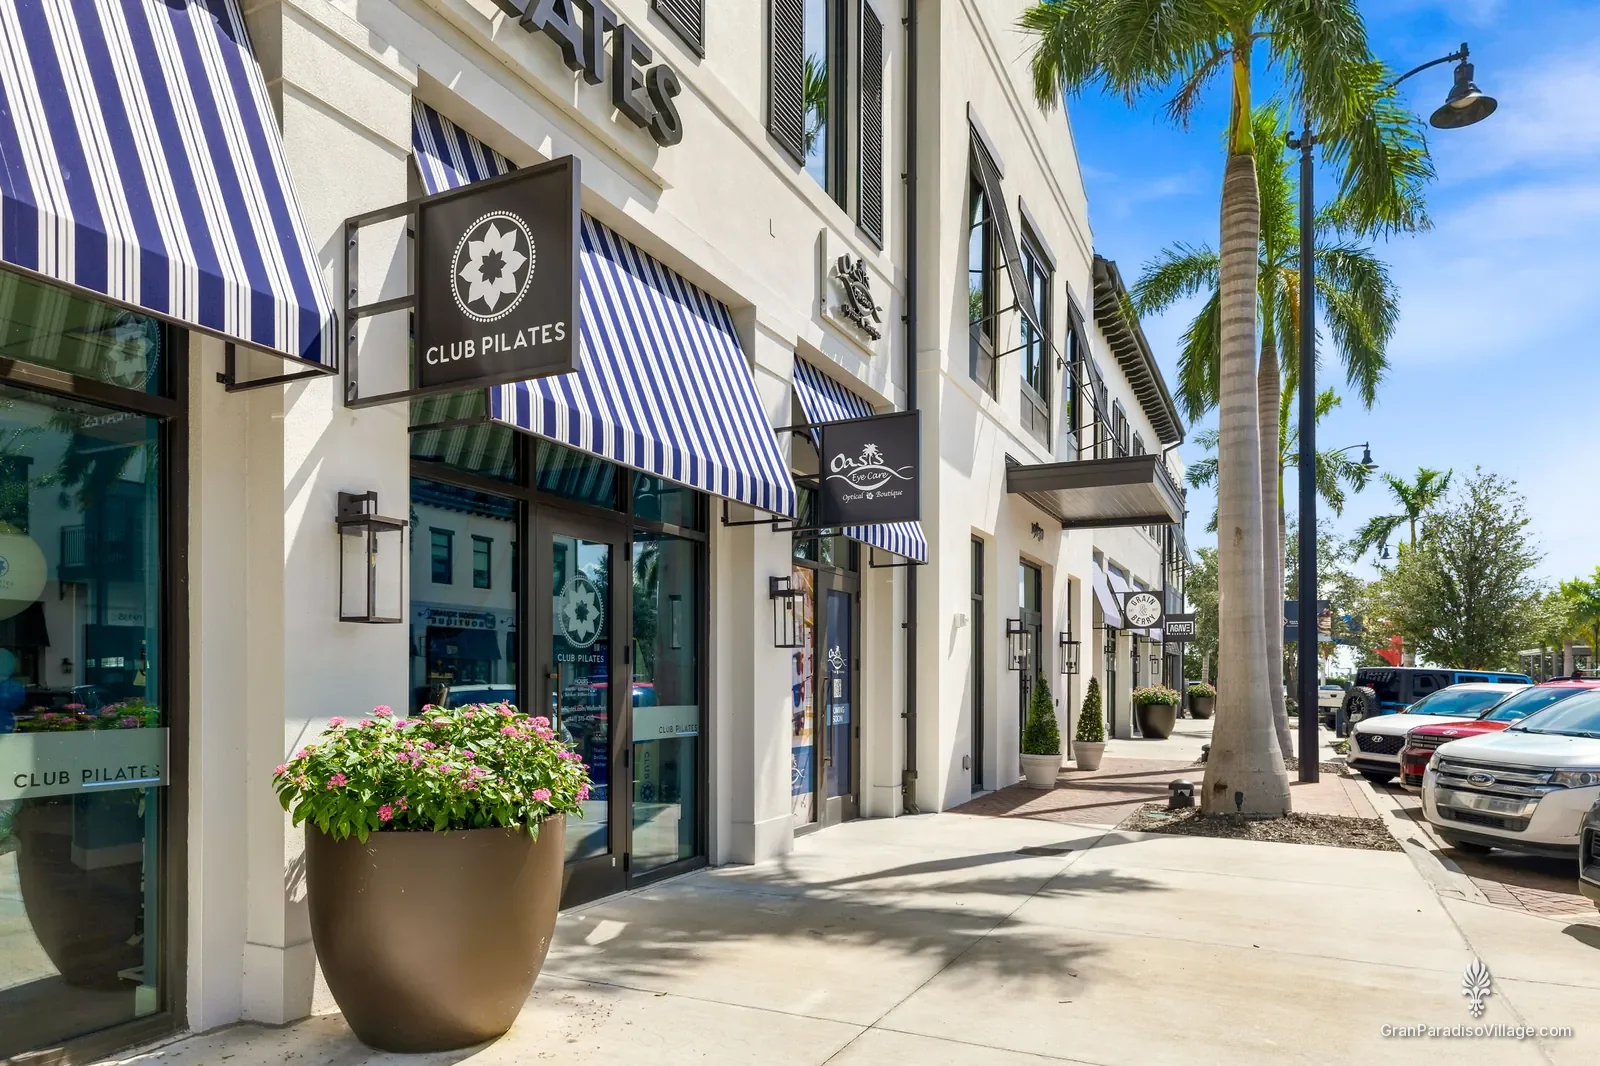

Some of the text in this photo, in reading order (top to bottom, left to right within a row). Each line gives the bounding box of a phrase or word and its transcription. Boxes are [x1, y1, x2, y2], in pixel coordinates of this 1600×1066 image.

[489, 0, 683, 147] ATES
[426, 321, 566, 365] CLUB PILATES
[830, 451, 885, 473] Oasis
[852, 471, 889, 484] Eye Care
[842, 489, 903, 503] Optical Boutique
[1130, 595, 1156, 606] GRAIN
[1130, 614, 1156, 625] BERRY
[1169, 624, 1191, 633] AGAVE
[557, 653, 605, 663] CLUB PILATES
[659, 724, 698, 734] CLUB PILATES
[13, 764, 161, 788] CLUB PILATES
